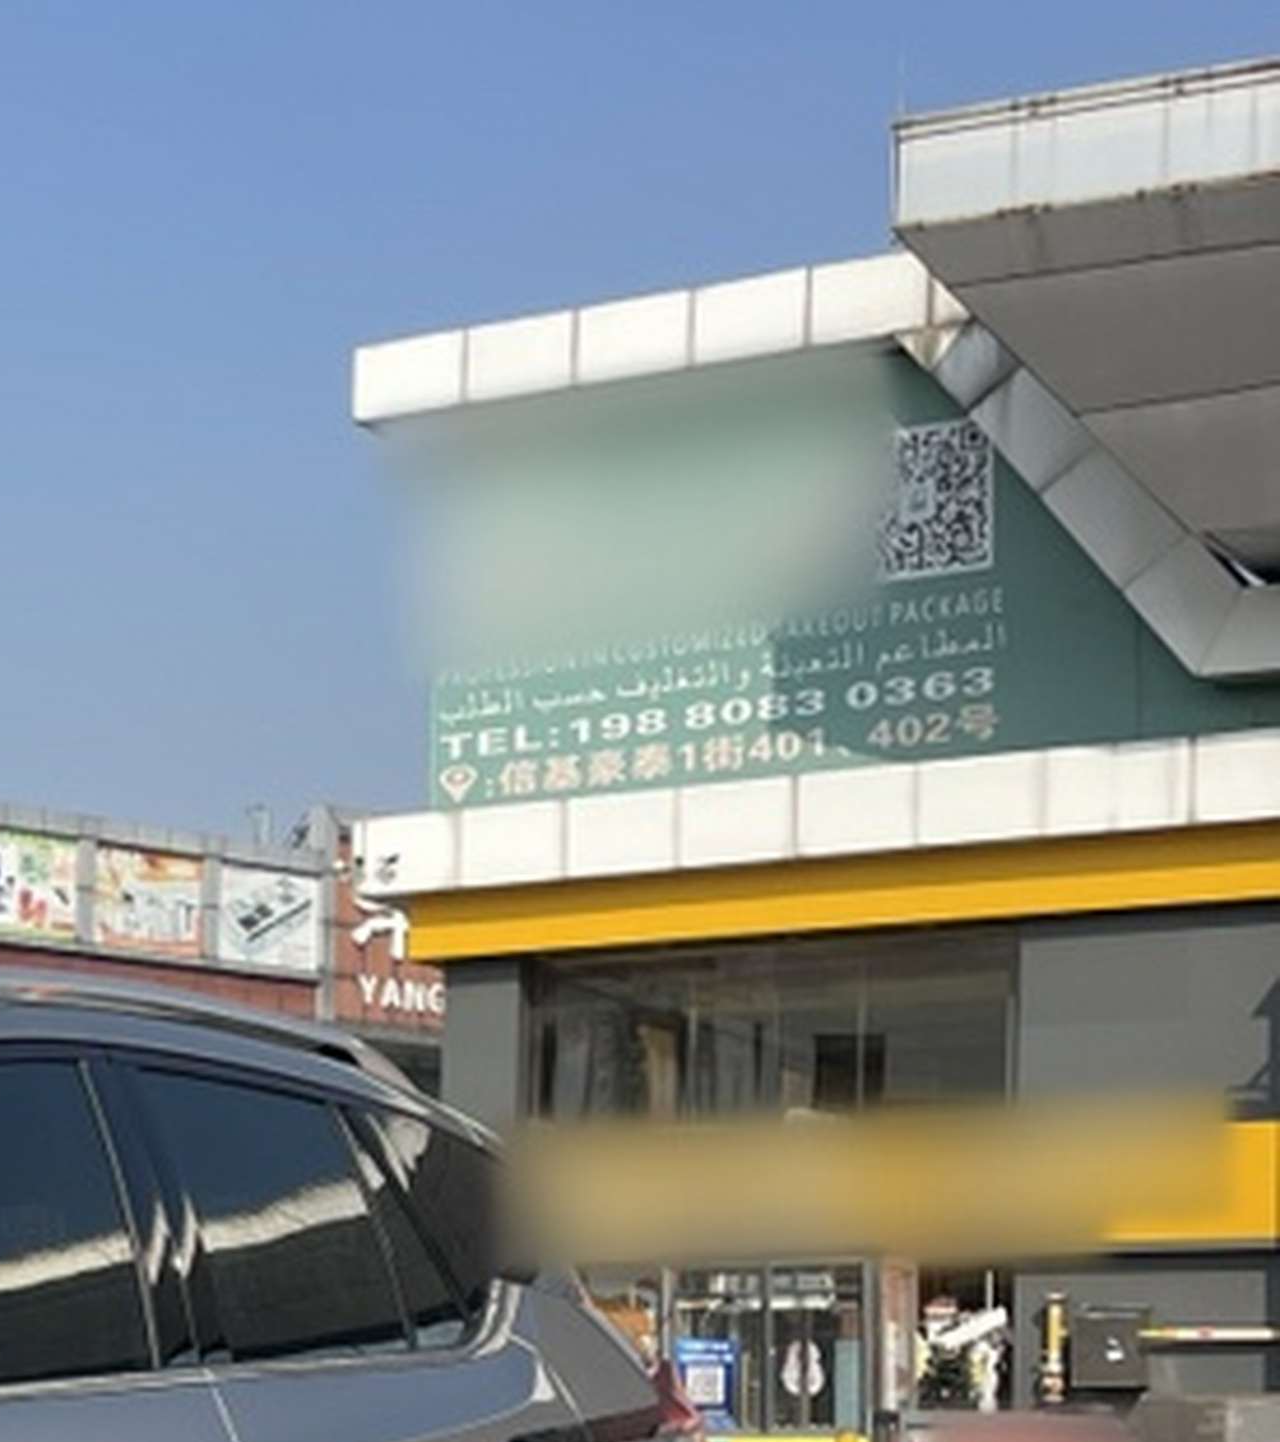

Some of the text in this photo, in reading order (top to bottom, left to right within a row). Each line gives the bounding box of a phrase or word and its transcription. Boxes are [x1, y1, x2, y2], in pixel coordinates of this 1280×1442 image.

[888, 586, 1004, 627] PACKAGE
[440, 666, 995, 759] TEL:198 8083 0363
